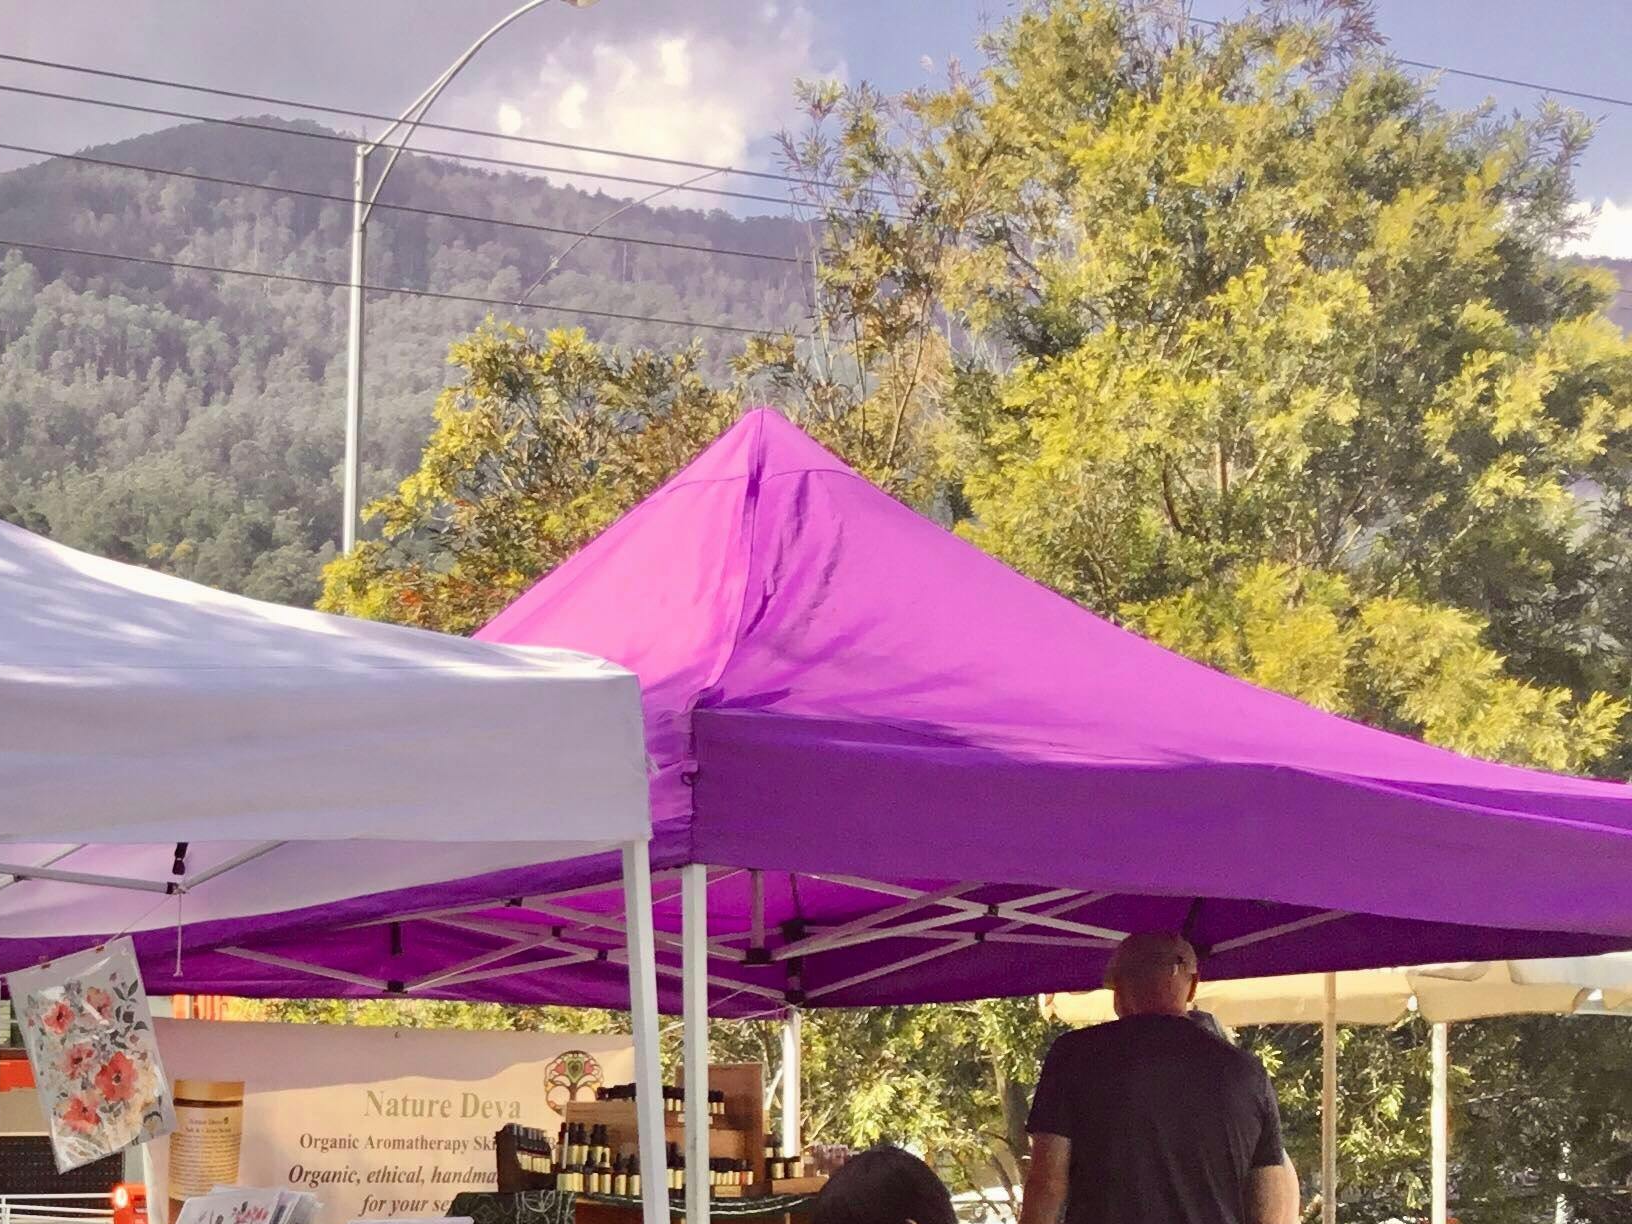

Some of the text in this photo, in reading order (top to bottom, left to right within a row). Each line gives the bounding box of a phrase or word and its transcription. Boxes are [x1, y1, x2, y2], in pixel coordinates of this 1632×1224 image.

[364, 1090, 522, 1120] Nature Deva
[299, 1133, 497, 1155] Organic Aromatherapy Ski
[288, 1164, 498, 1188] Organic, ethical, handma
[358, 1193, 451, 1217] for your se
